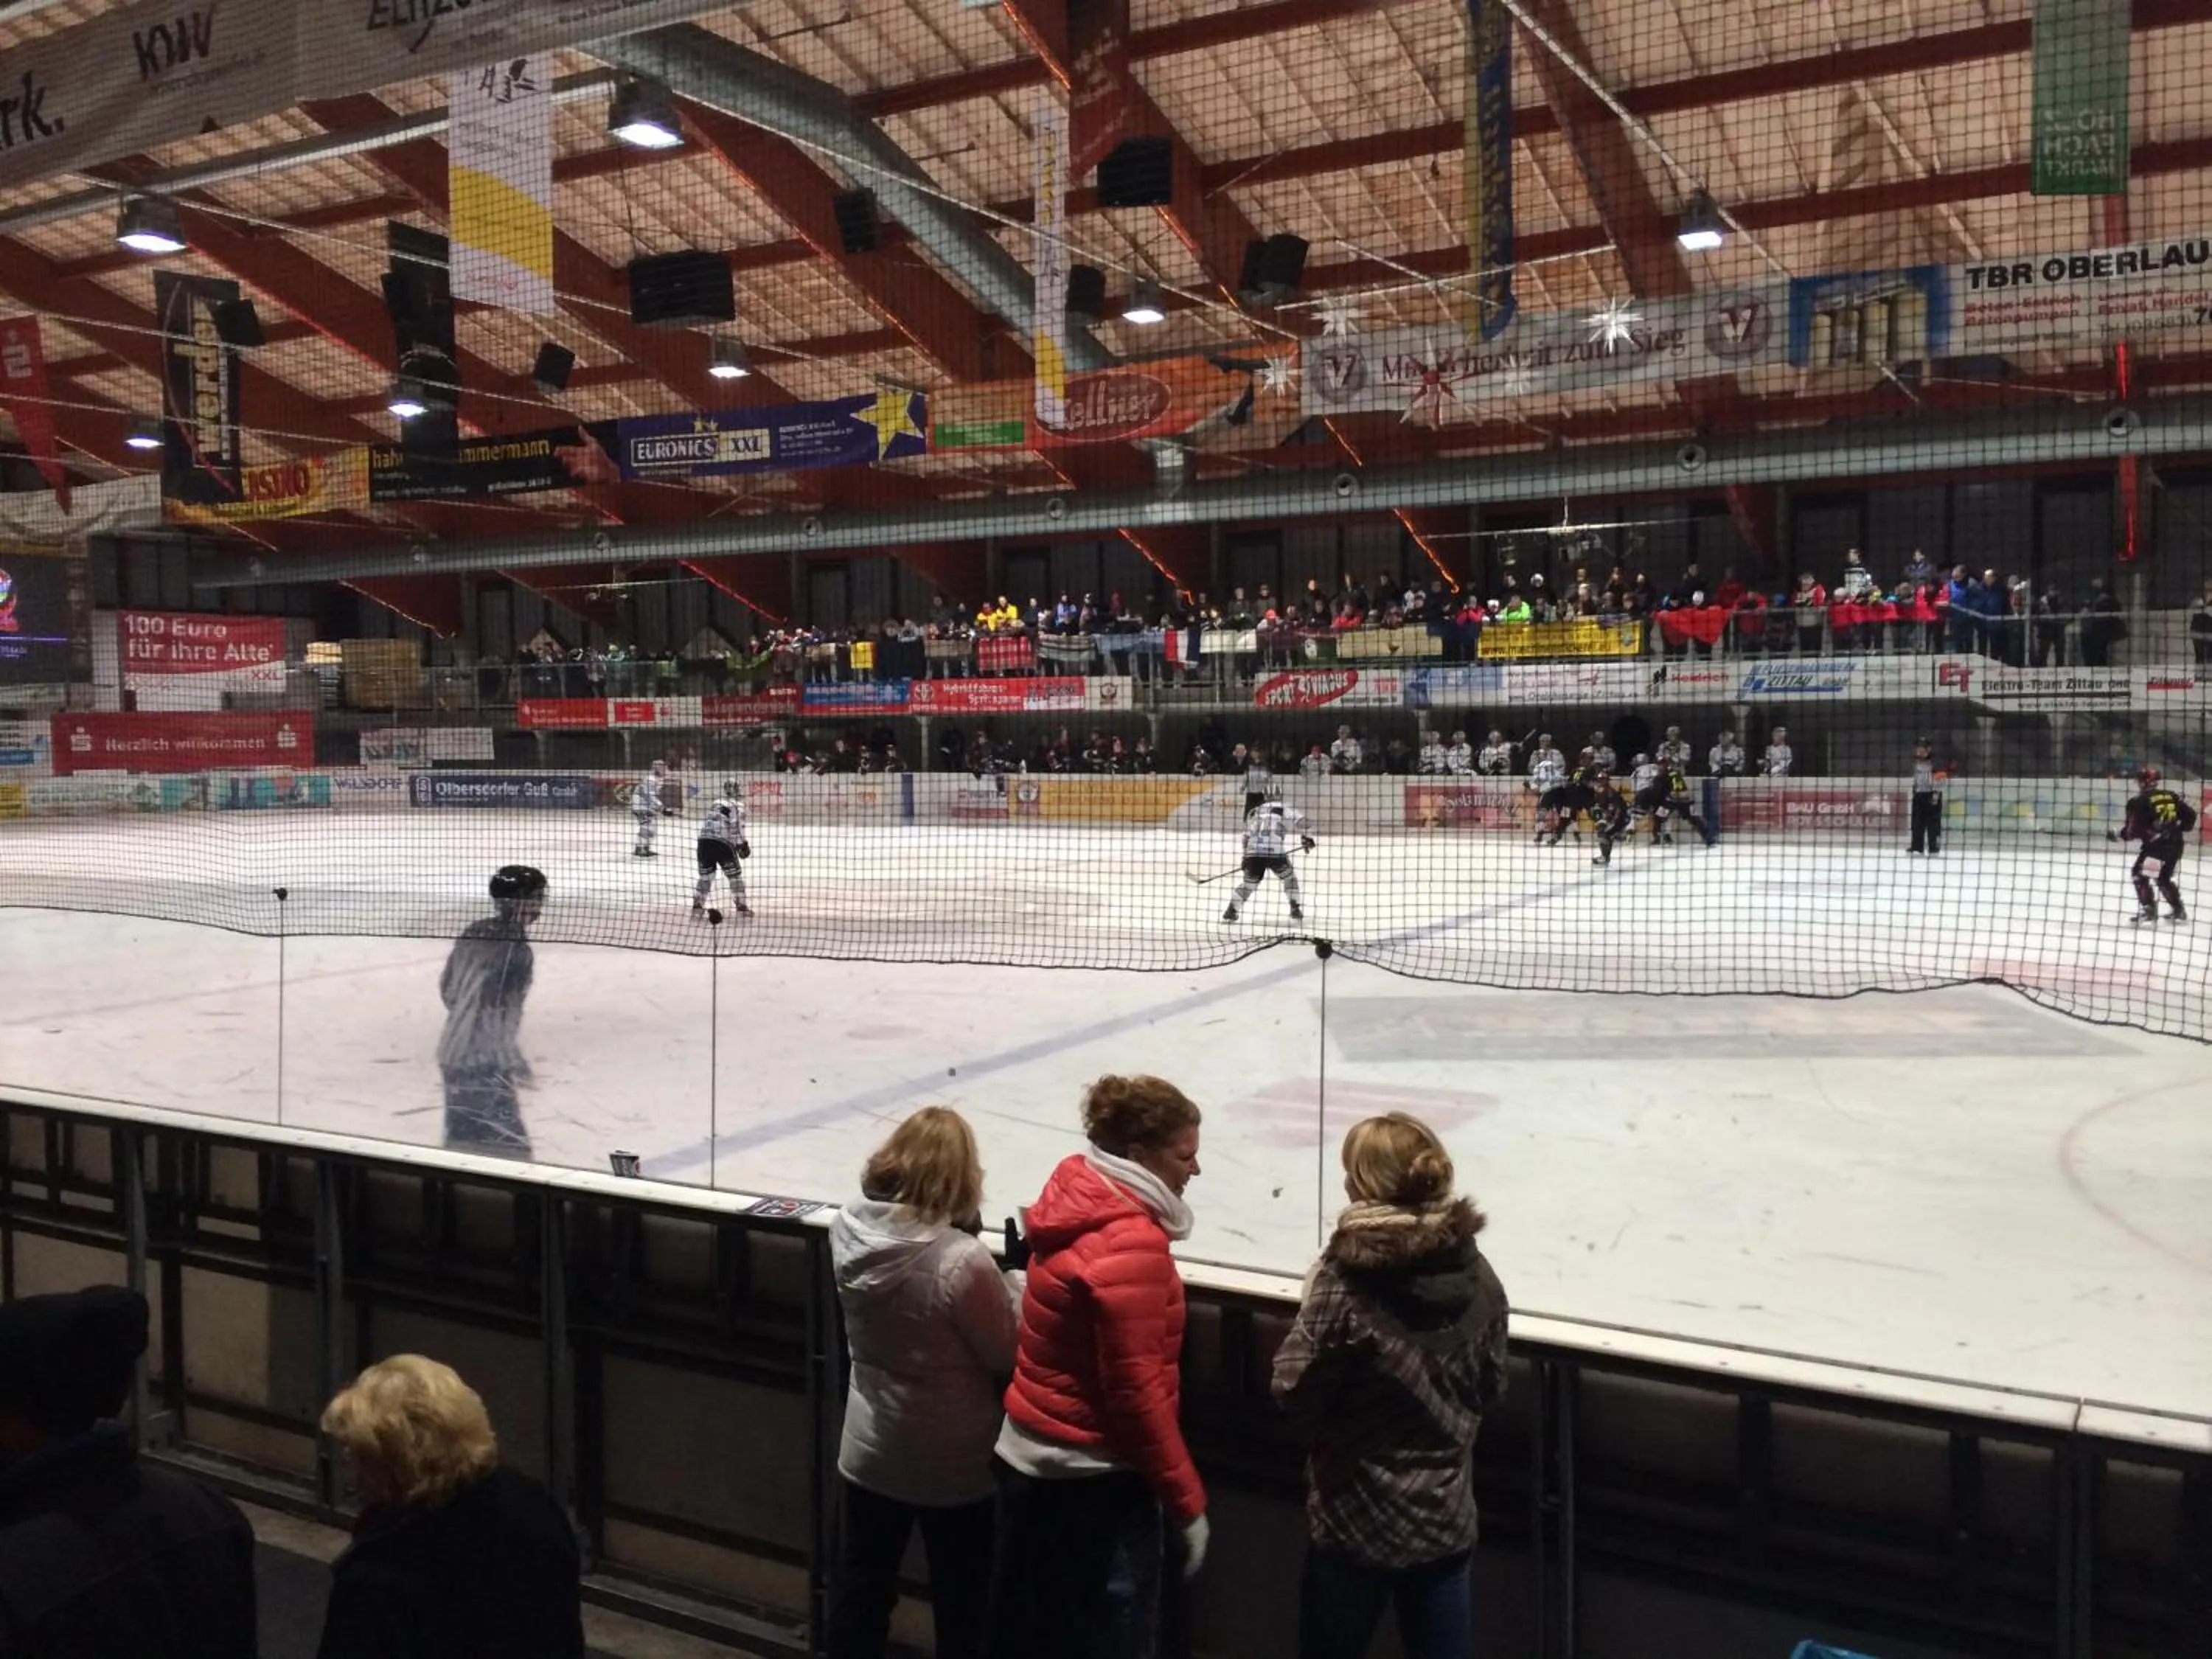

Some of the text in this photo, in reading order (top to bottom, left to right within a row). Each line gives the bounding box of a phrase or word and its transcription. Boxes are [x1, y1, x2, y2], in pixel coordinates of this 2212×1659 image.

[1965, 240, 2209, 289] TBR OBERLAU
[1630, 326, 1686, 356] Sieg
[459, 439, 550, 463] immermann
[637, 440, 717, 460] EURONICS
[124, 613, 227, 638] 100 Euro
[128, 639, 164, 658] für
[171, 639, 216, 660] ihre
[105, 737, 169, 751] Herzlich
